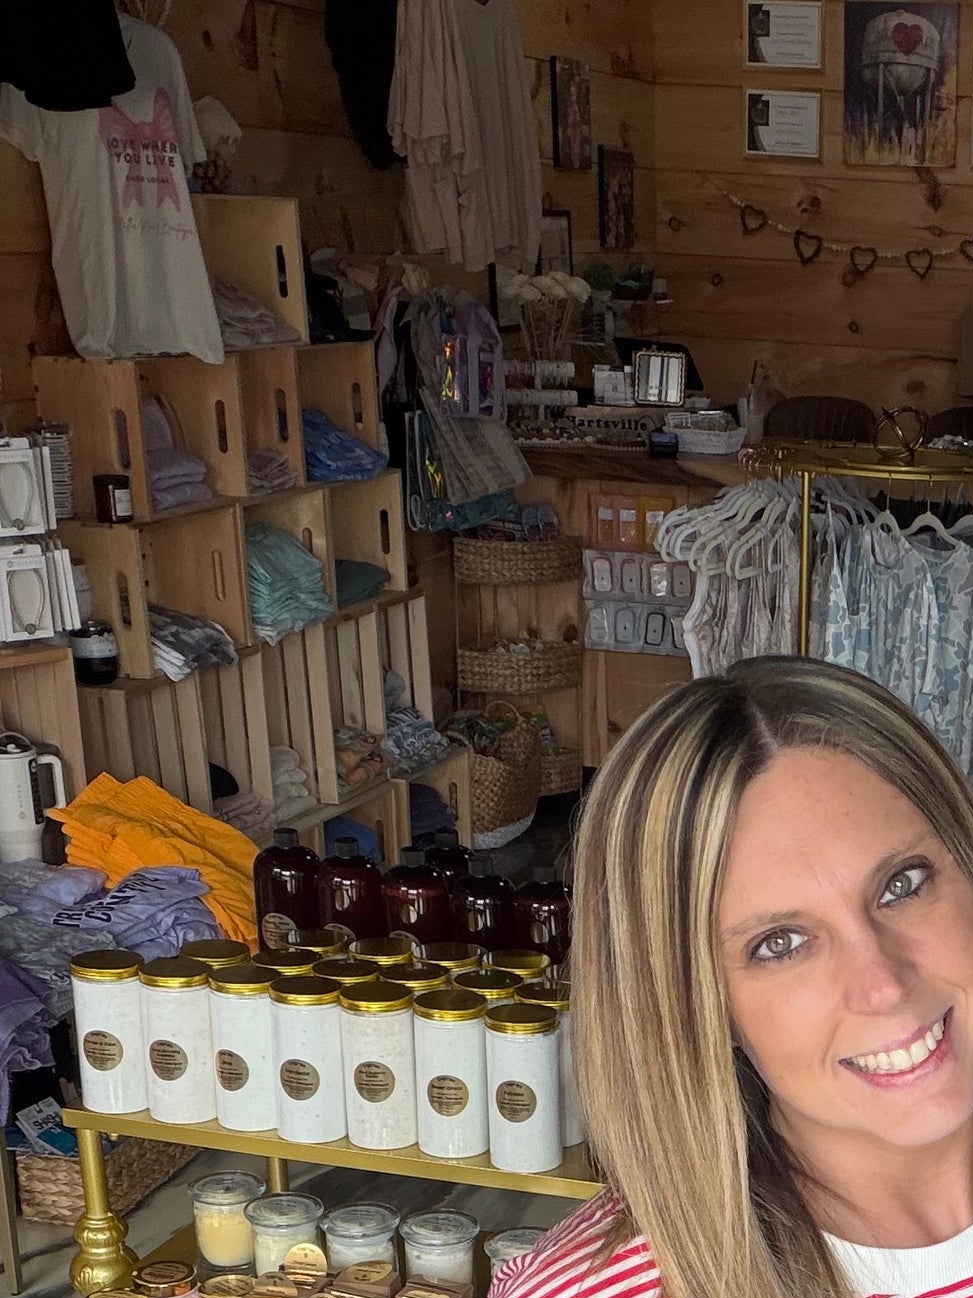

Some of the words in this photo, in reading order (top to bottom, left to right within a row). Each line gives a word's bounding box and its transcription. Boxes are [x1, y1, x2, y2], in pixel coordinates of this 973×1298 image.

[142, 140, 178, 154] WHER
[115, 152, 141, 164] YOU
[146, 155, 176, 168] LIVE
[566, 415, 648, 431] Hartsville
